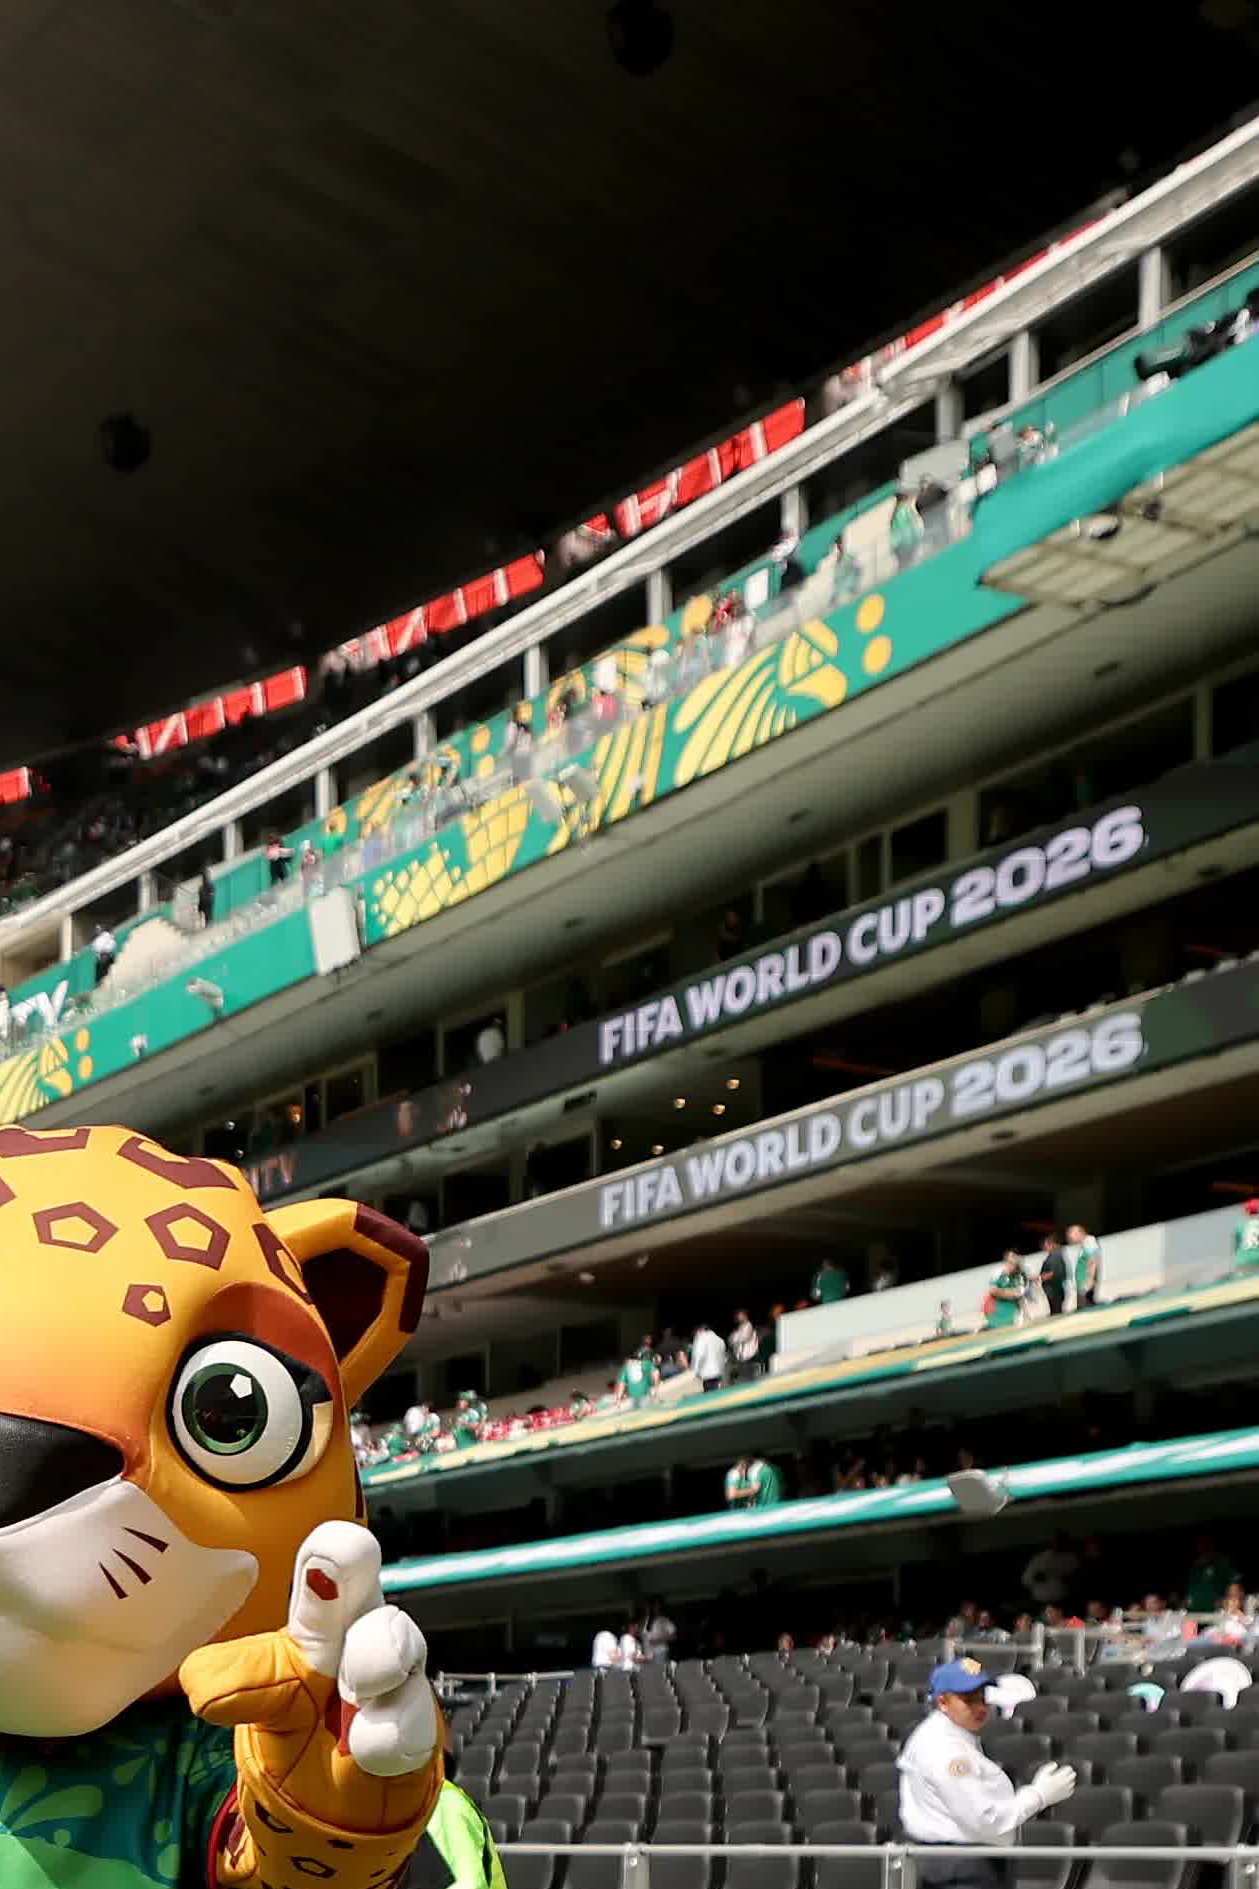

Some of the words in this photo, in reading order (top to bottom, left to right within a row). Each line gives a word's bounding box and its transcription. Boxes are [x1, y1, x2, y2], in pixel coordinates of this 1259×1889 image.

[599, 995, 683, 1064] FIFA
[685, 931, 842, 1029] WORLD
[847, 887, 945, 965] CUP
[950, 805, 1144, 927] 2026
[599, 1164, 683, 1227] FIFA
[685, 1112, 841, 1197] WORLD
[847, 1077, 945, 1149] CUP
[950, 1012, 1143, 1117] 2026
